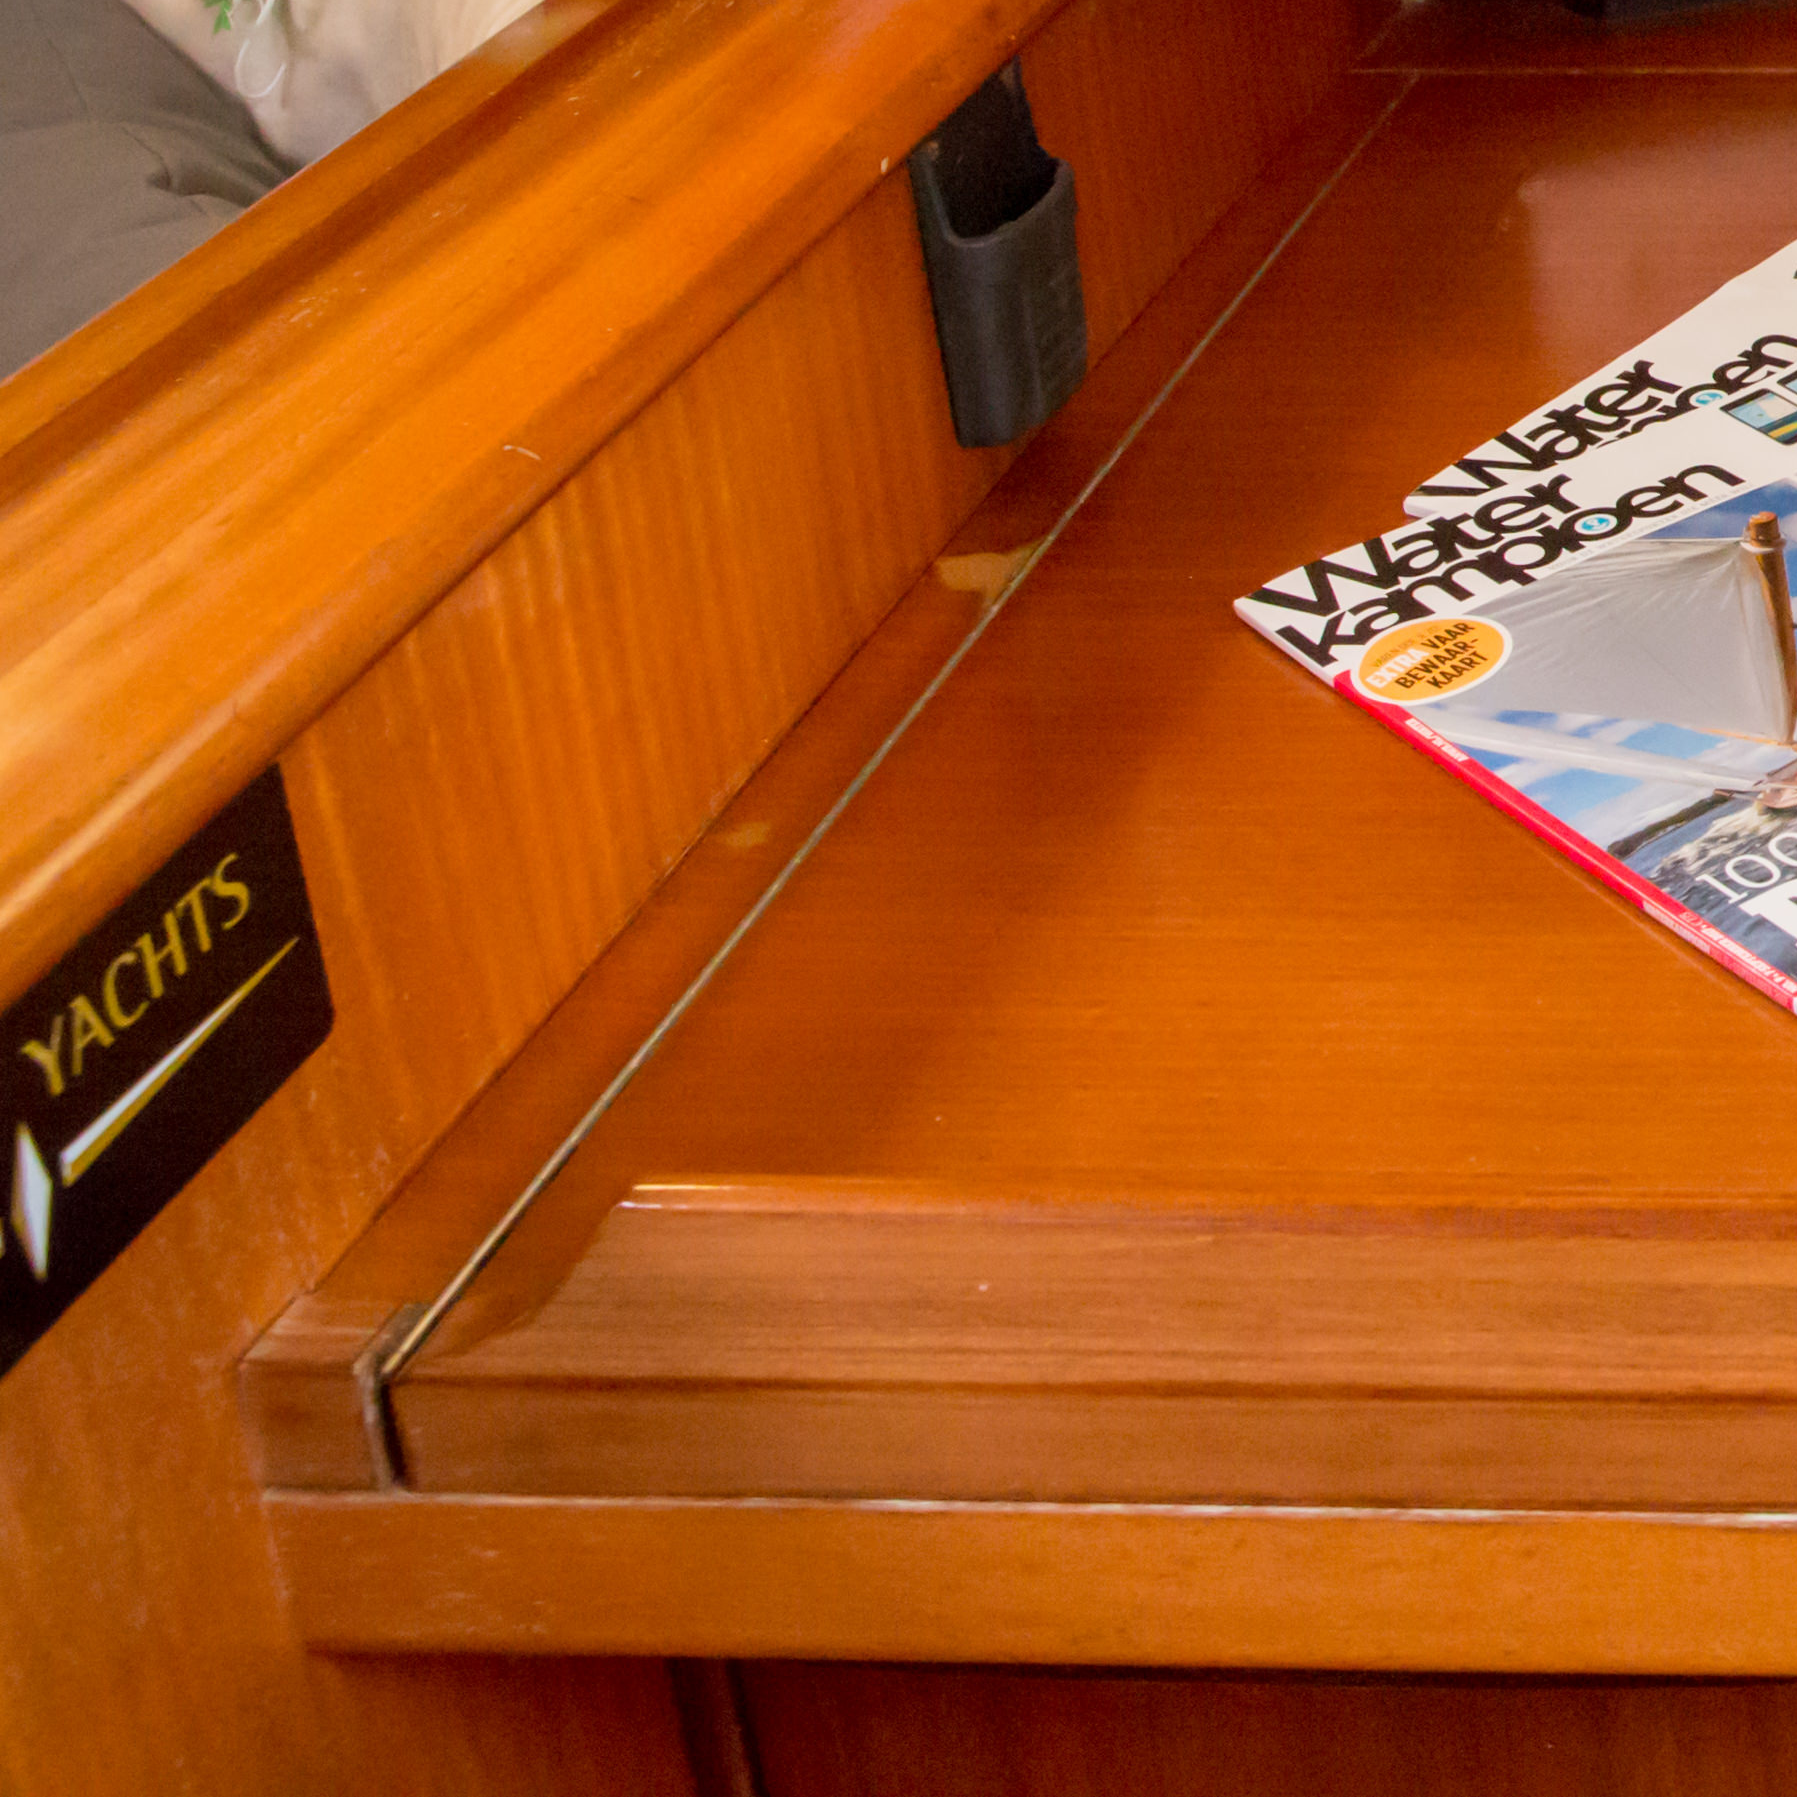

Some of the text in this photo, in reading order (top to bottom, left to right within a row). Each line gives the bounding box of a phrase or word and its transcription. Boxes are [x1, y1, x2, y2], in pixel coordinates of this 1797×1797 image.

[1408, 359, 1683, 497] Water
[1245, 473, 1581, 617] Water
[1275, 464, 1746, 667] kampioen
[1364, 647, 1430, 690] EXTRA
[1420, 621, 1476, 651] VAAR
[1394, 638, 1479, 690] BEWAAR-
[1426, 650, 1489, 690] KAART
[20, 850, 252, 1098] YACHTS
